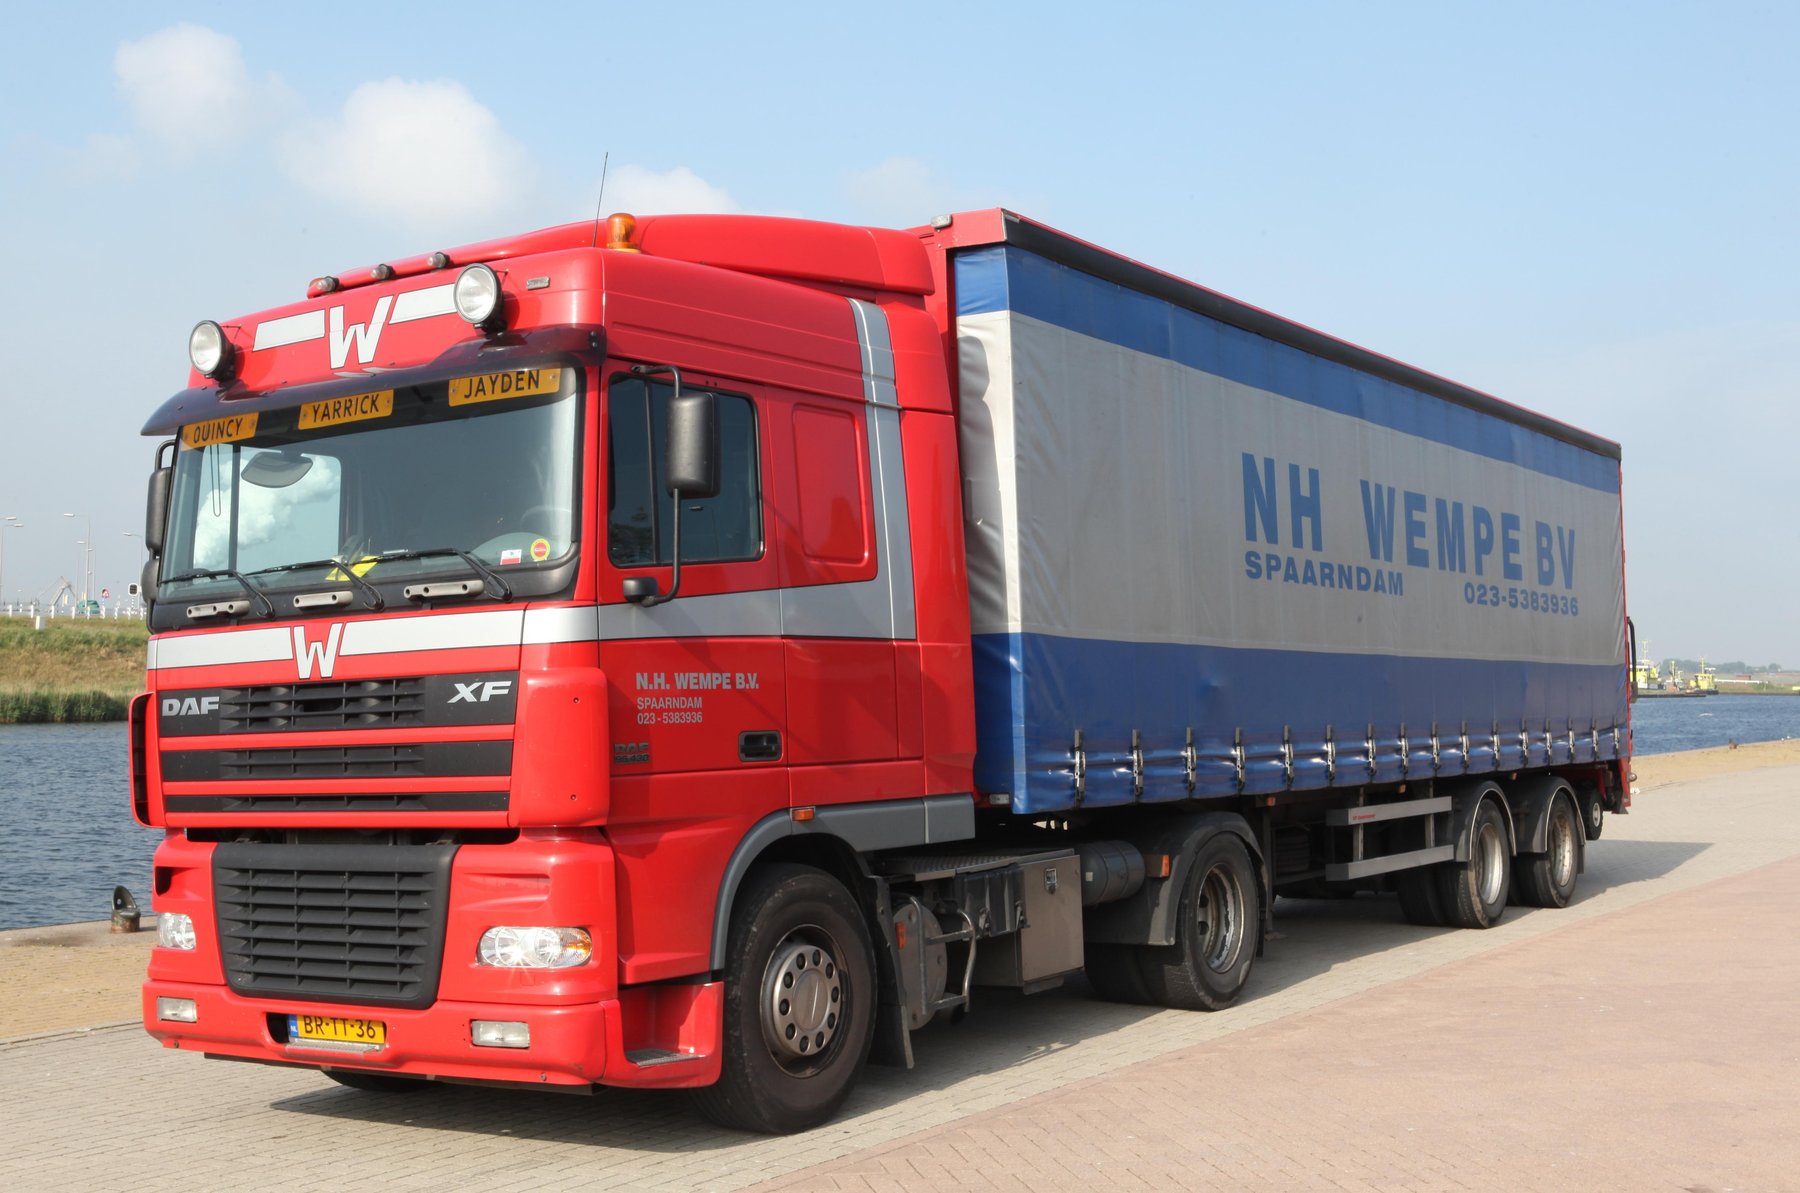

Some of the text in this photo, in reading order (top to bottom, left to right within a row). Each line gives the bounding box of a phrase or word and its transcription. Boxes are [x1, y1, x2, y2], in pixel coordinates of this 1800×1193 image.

[329, 295, 394, 369] W
[464, 369, 540, 399] JAYDEN
[312, 393, 380, 423] YARRICK
[1241, 452, 1576, 590] NH WEMPE BV
[1244, 550, 1404, 597] SPAARNDAM
[1464, 582, 1579, 617] 023-5383936
[293, 622, 344, 680] W
[447, 680, 513, 704] XF
[636, 672, 759, 690] N.H. WEMPE B.V.
[161, 696, 220, 717] DAF
[636, 697, 703, 710] SPAARNDAM
[303, 1015, 376, 1039] BR-TT-36
